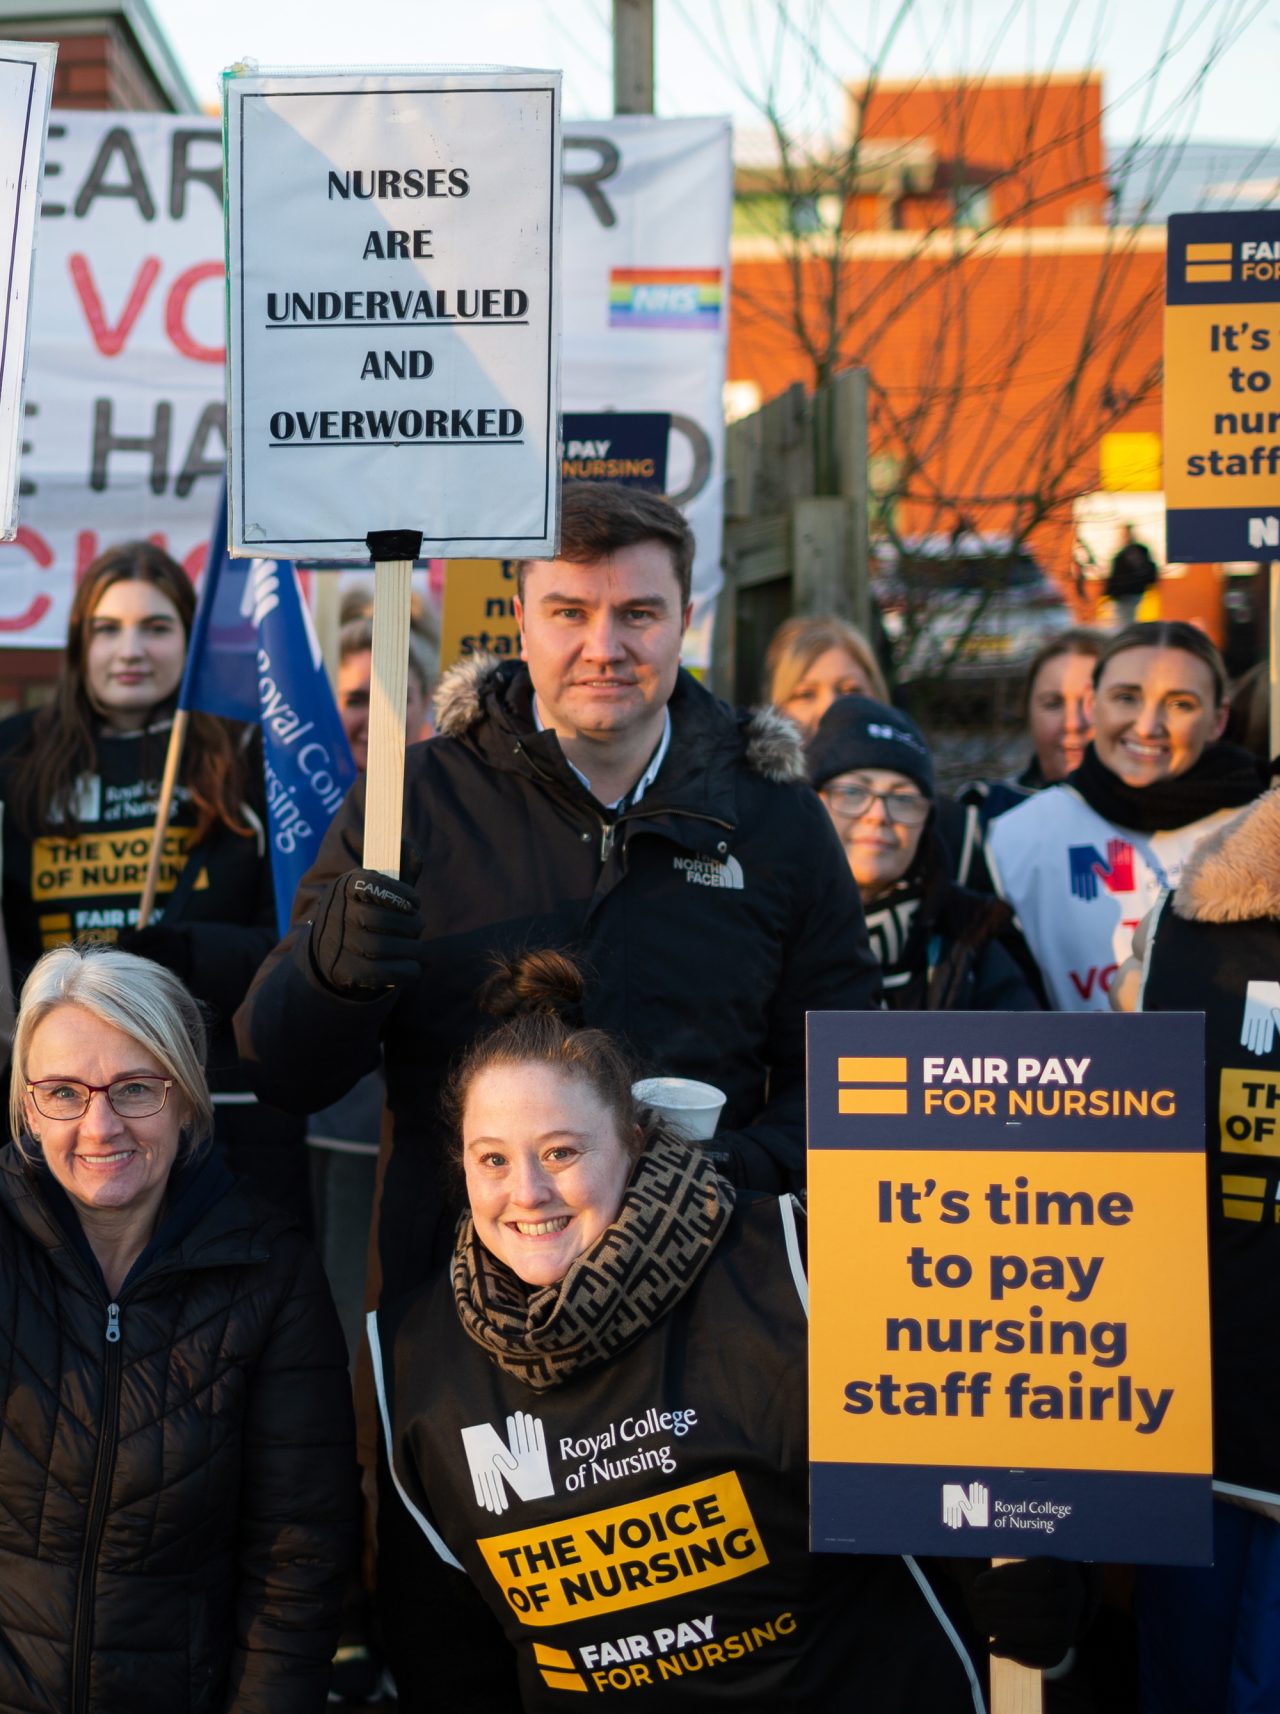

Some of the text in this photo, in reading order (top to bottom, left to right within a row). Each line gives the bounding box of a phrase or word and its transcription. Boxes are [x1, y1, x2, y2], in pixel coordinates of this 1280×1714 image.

[328, 168, 470, 200] NURSES
[363, 229, 434, 260] ARE
[266, 288, 529, 322] UNDERVALUED
[633, 285, 697, 314] NHS
[1210, 322, 1271, 352] It's
[360, 350, 434, 380] AND
[1228, 366, 1271, 393] to
[269, 408, 525, 440] OVERWORKED
[567, 440, 612, 459] PAY
[562, 458, 655, 478] NURSING
[110, 837, 188, 858] VOCE
[36, 868, 72, 890] OF
[673, 857, 720, 874] NORTH
[686, 870, 720, 887] FACE
[75, 909, 125, 928] FAIR
[922, 1057, 1091, 1085] FAIR PAY
[923, 1088, 1177, 1117] FOR NURSING
[1225, 1115, 1276, 1142] OF
[878, 1176, 1134, 1226] It's time
[906, 1246, 1105, 1302] to pay
[885, 1304, 1128, 1368] nursing
[843, 1371, 1175, 1434] staff fairly
[559, 1406, 698, 1463] Royal College
[564, 1445, 677, 1492] of Nursing
[994, 1500, 1072, 1519] Royal College
[498, 1493, 726, 1578] THE VOICE
[994, 1516, 1055, 1534] of Nursing
[507, 1526, 757, 1614] OF NURSING
[579, 1614, 715, 1669] FAIR PAY
[591, 1611, 798, 1693] FOR NURSING
